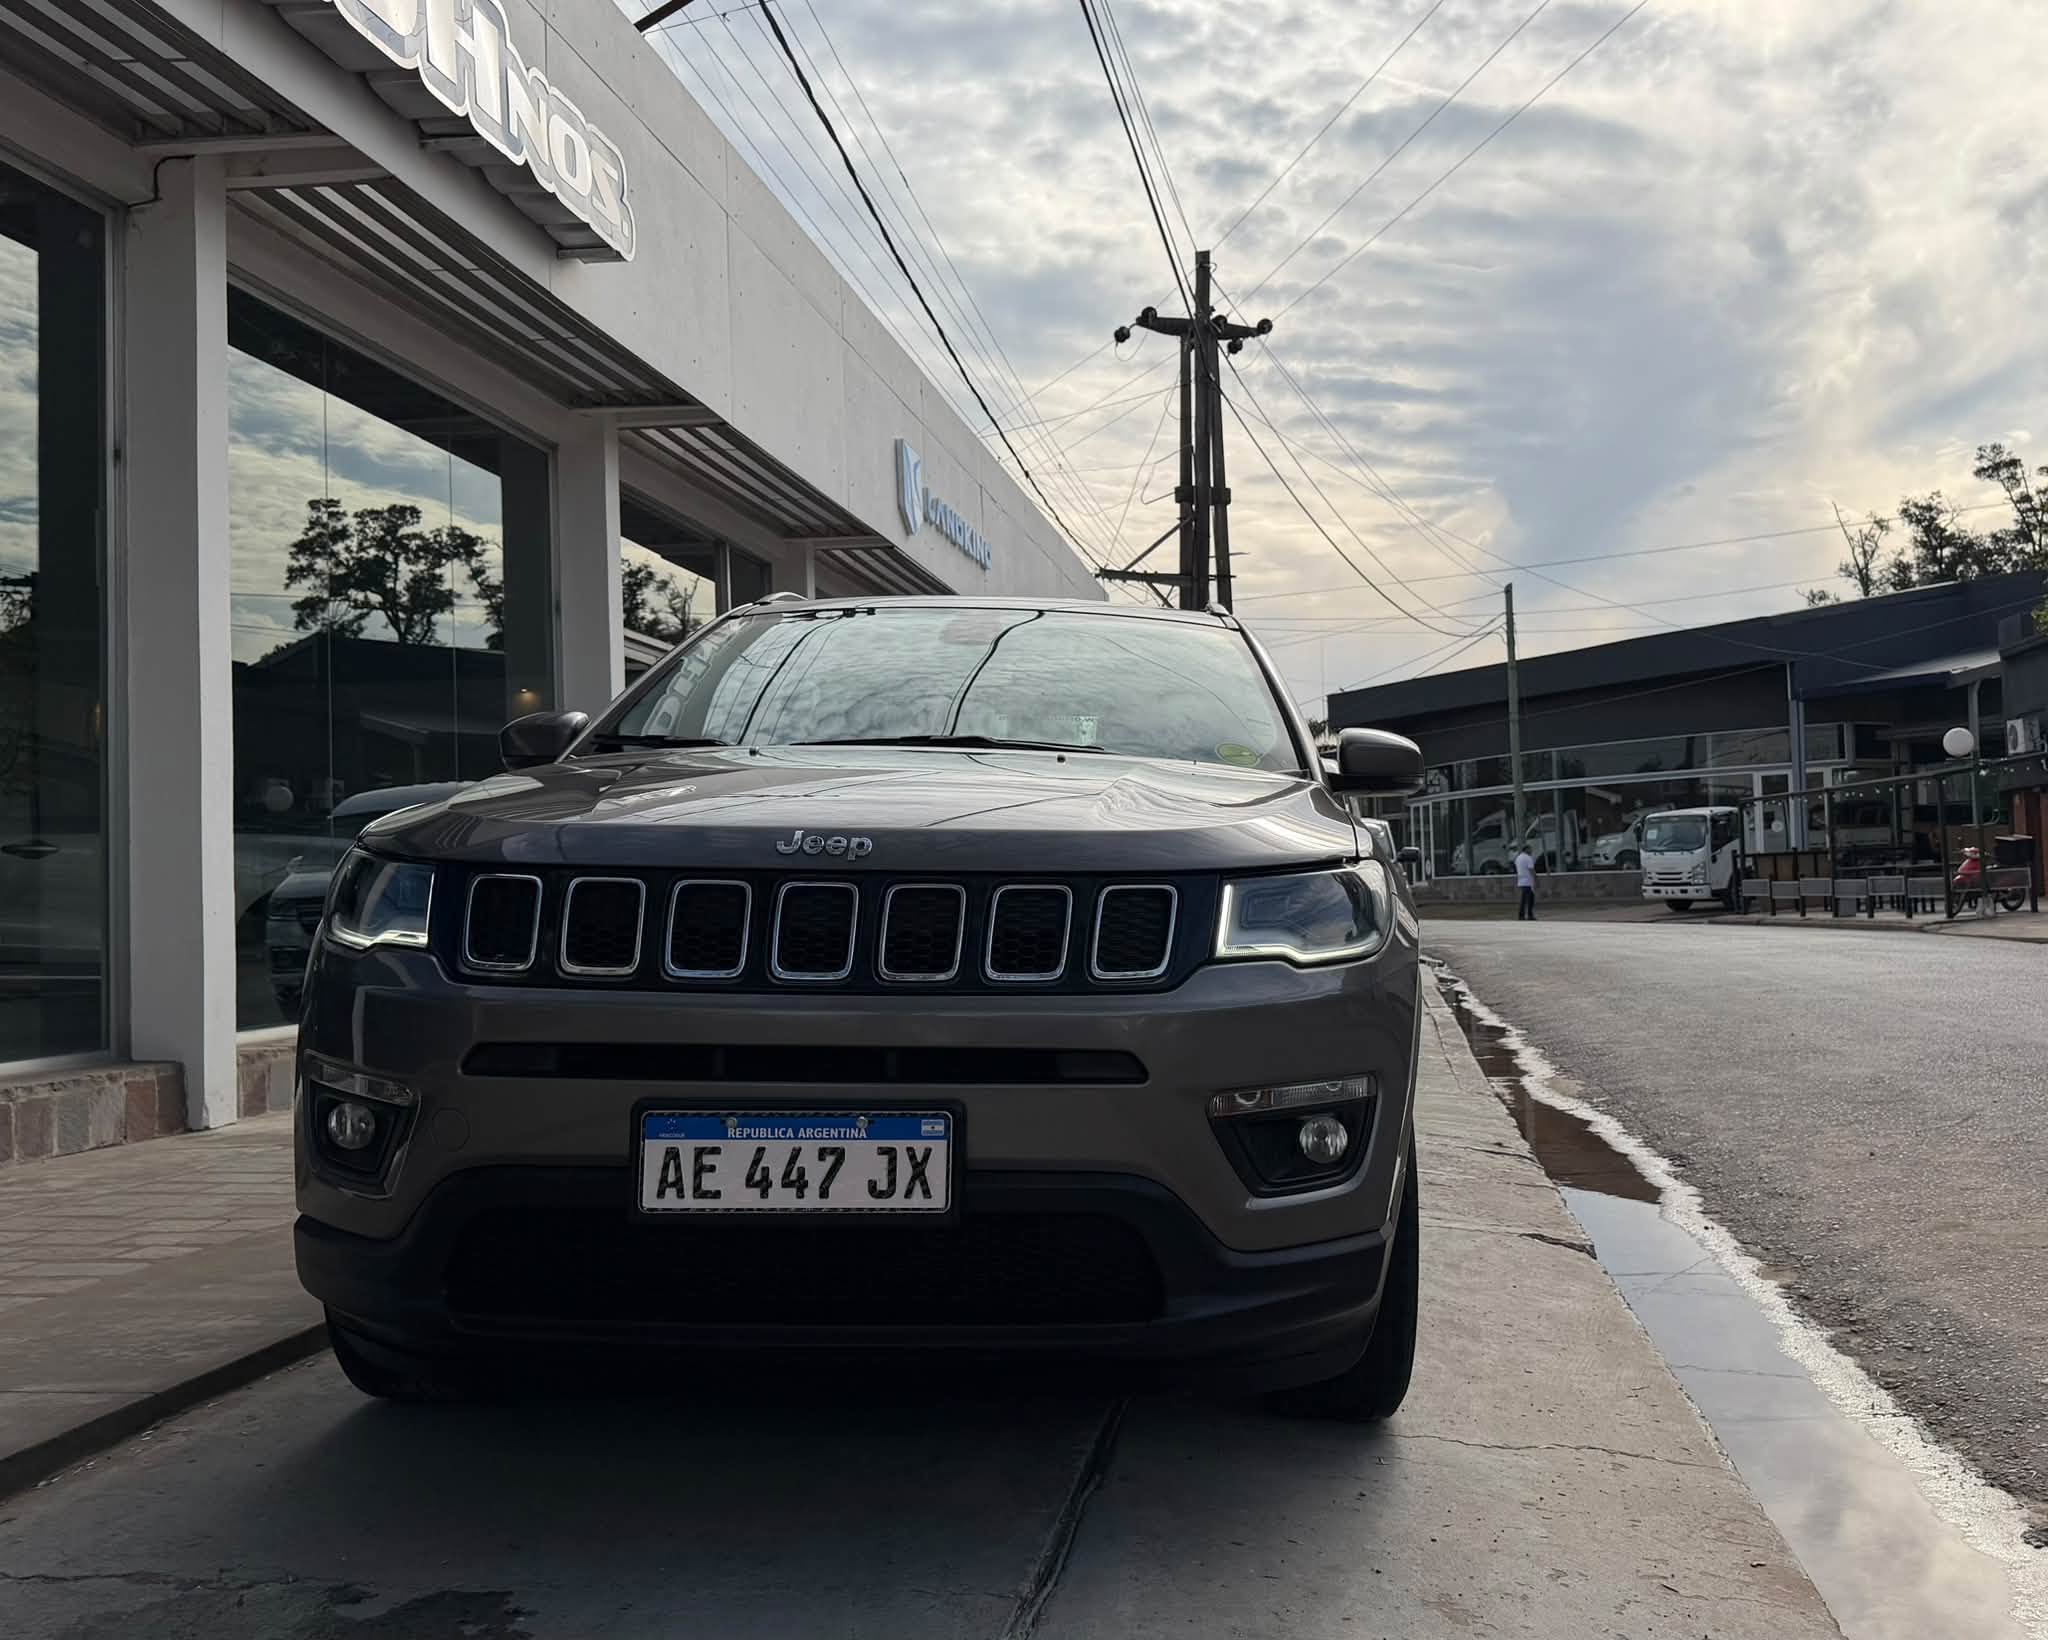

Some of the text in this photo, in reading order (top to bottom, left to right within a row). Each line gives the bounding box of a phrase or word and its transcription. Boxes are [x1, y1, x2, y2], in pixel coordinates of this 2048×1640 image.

[776, 830, 873, 860] Jeep
[728, 1127, 868, 1139] REPUBLICA ARGENTINA
[656, 1146, 933, 1200] AE 447 JX
